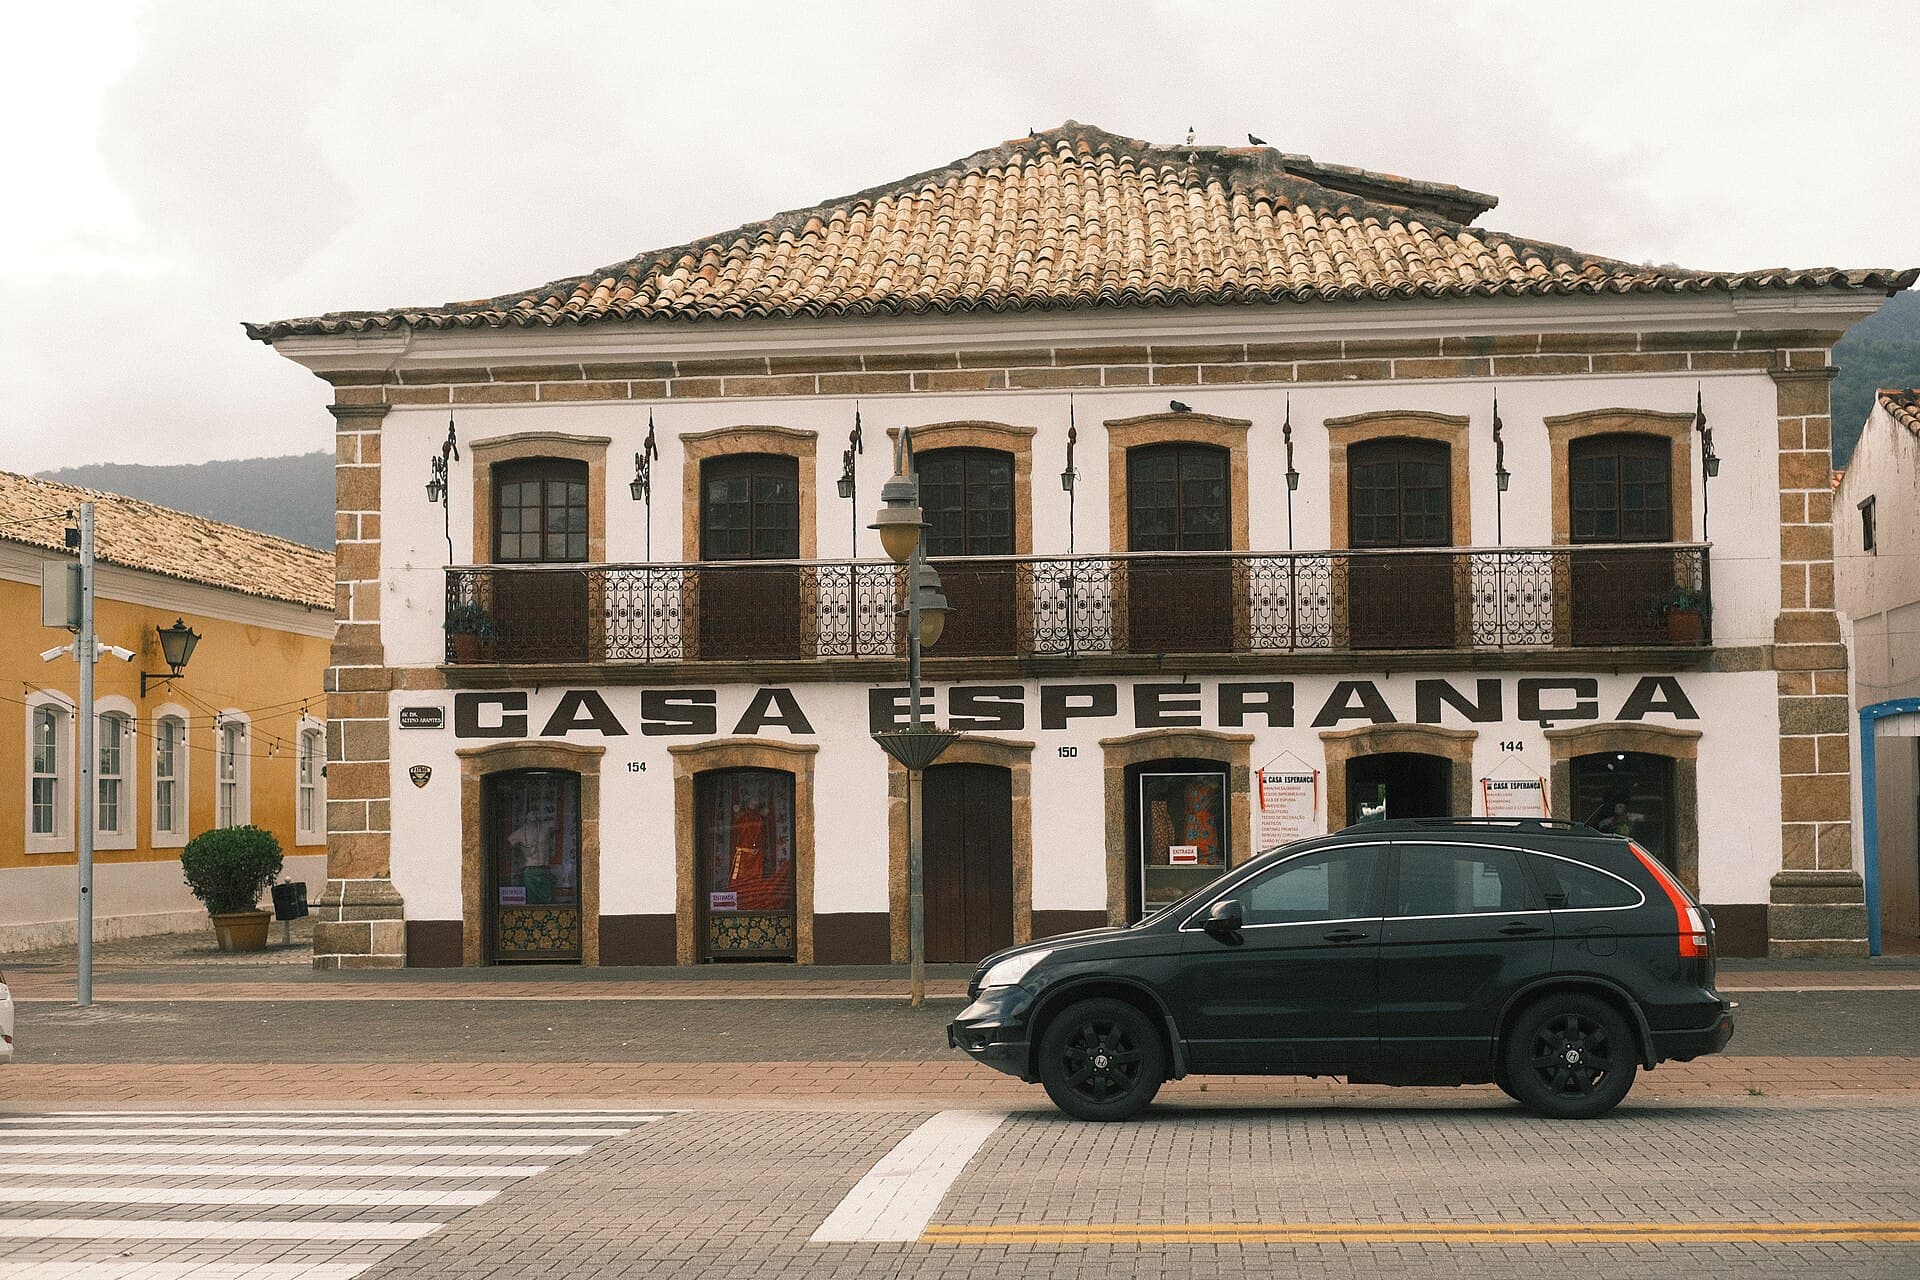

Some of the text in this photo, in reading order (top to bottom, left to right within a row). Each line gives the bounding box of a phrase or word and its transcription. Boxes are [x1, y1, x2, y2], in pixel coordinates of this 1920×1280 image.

[454, 676, 1700, 738] CASA ESPERANÇA
[1499, 741, 1523, 751] 144
[1057, 746, 1077, 757] 150
[627, 762, 647, 772] 154
[1493, 782, 1540, 790] CASA ESPERANÇA
